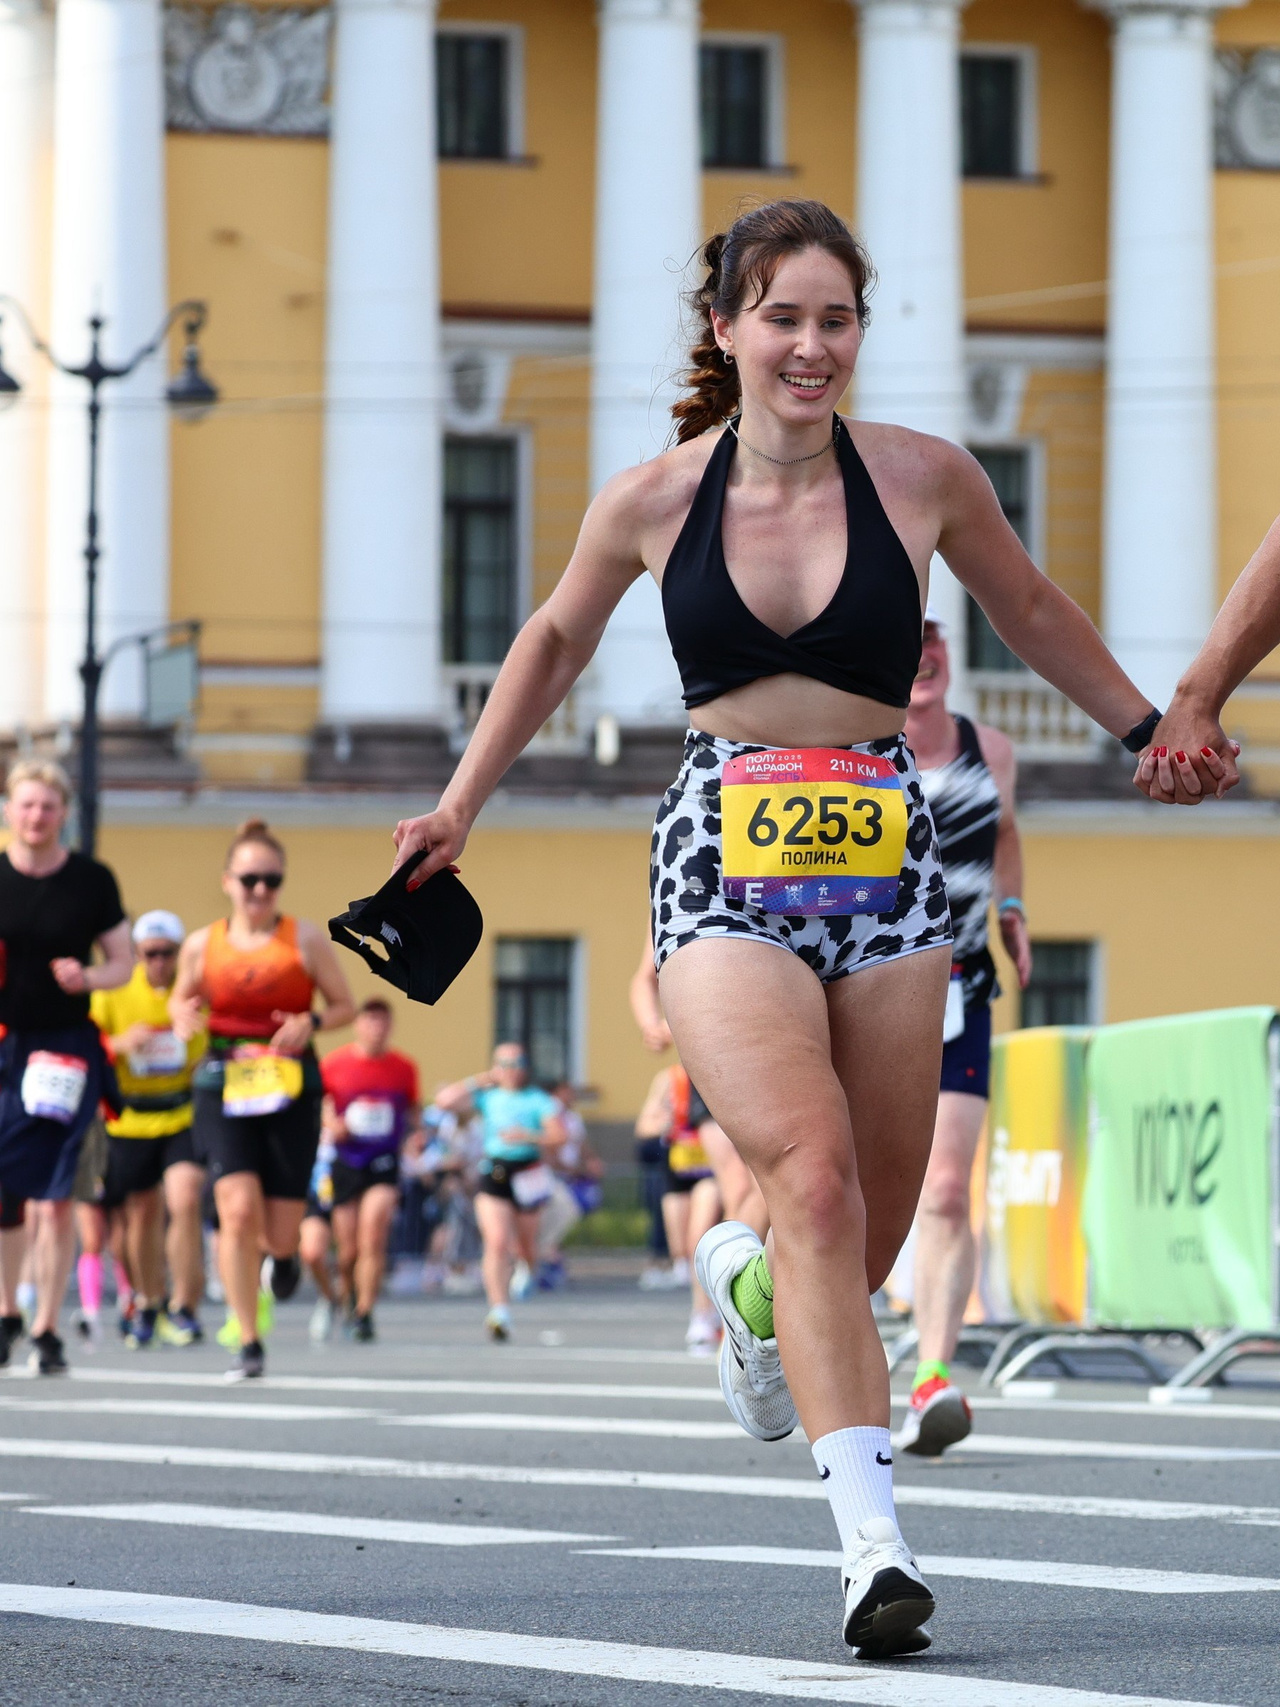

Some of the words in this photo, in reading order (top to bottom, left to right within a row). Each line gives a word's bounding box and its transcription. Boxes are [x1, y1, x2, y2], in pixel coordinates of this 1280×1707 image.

[745, 762, 803, 773] МАРАФОН
[746, 753, 776, 765] ПОЛУ
[829, 758, 854, 774] 21,1
[857, 763, 878, 778] КМ
[747, 796, 883, 848] 6253
[781, 851, 848, 866] ПОЛИНА
[745, 882, 764, 909] E
